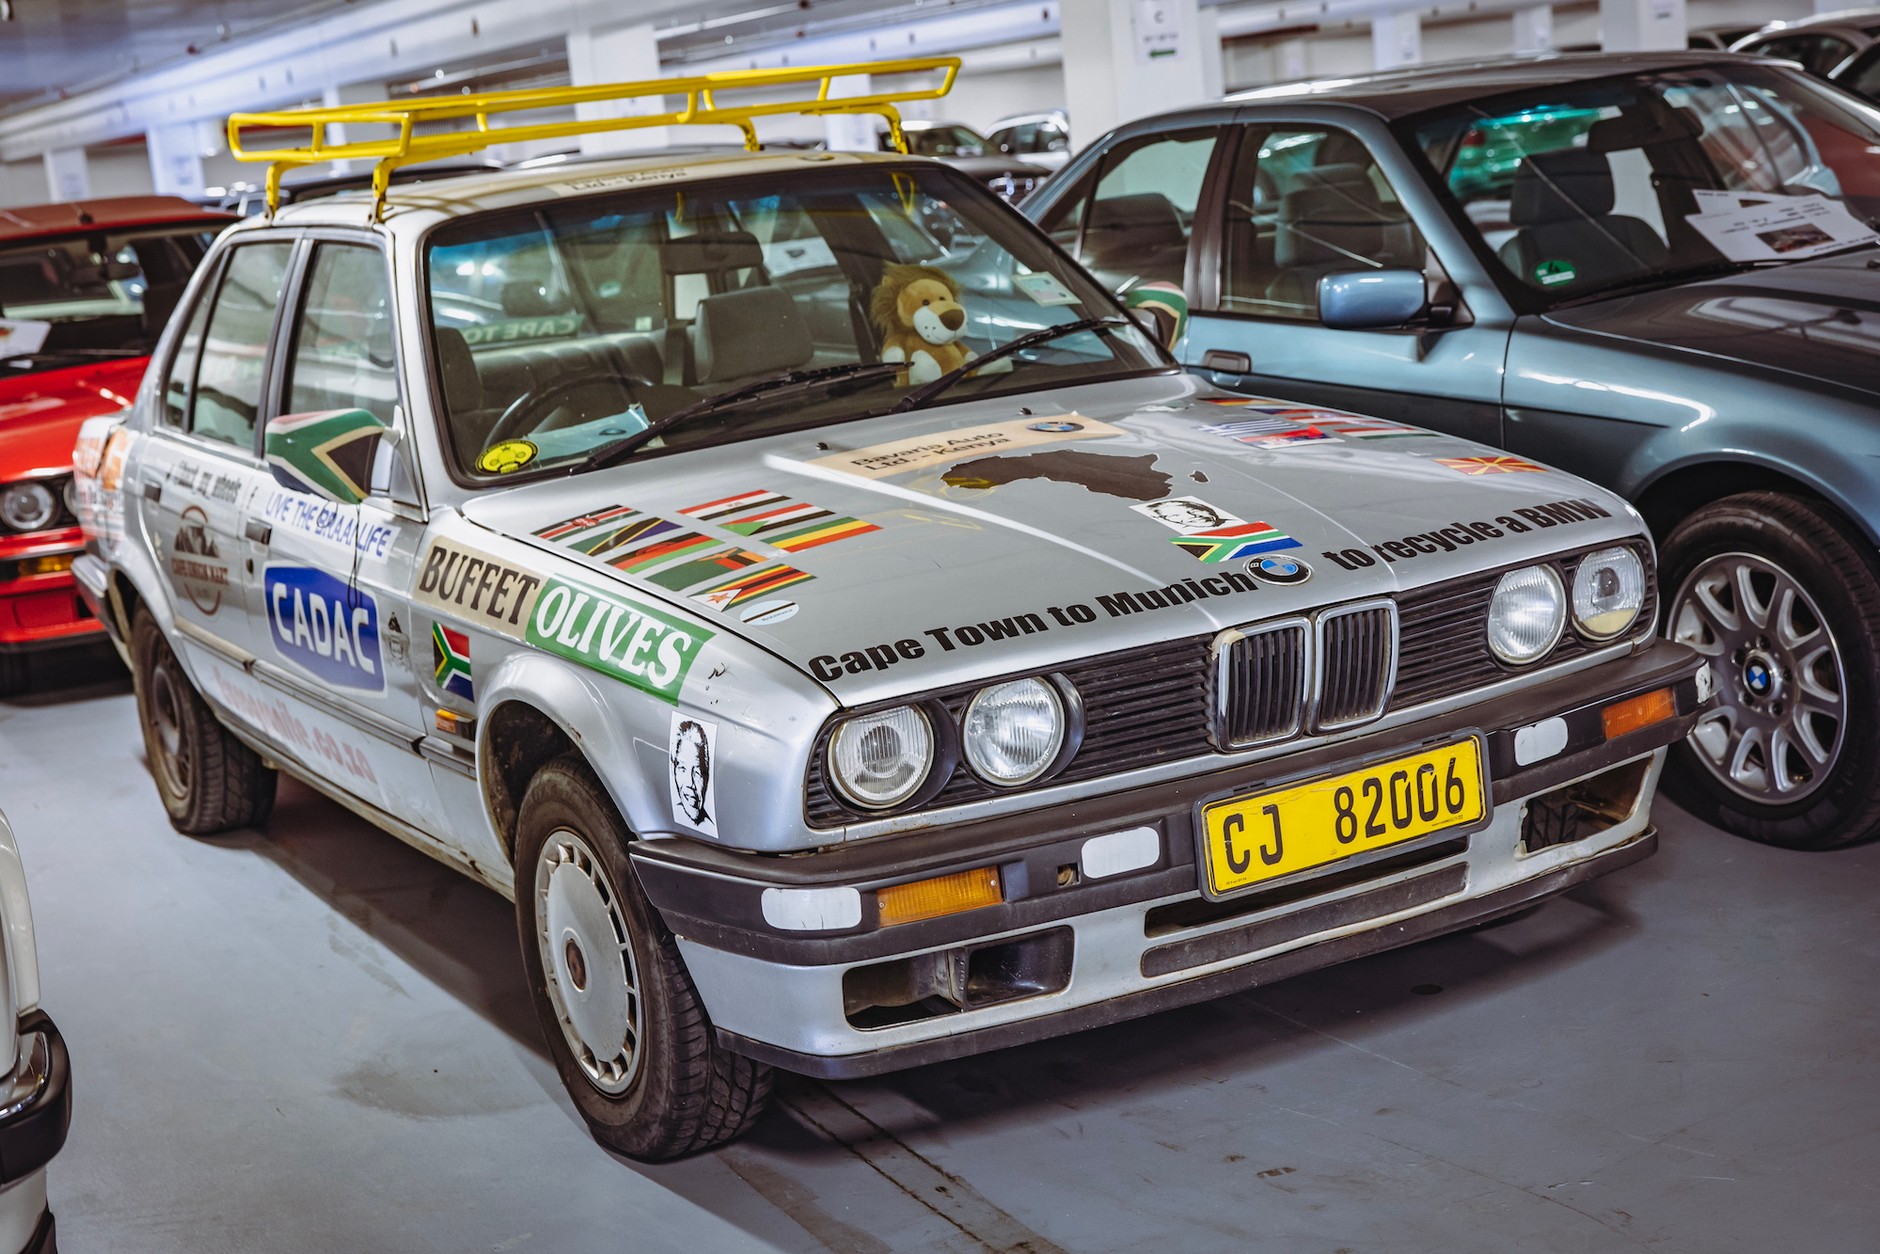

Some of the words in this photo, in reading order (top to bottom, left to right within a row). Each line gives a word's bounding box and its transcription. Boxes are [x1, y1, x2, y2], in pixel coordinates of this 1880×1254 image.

[850, 441, 943, 466] Bavaria
[946, 431, 1004, 446] Auto
[864, 456, 918, 471] Ltd.
[932, 436, 1012, 455] Kenya
[266, 490, 294, 522] LIVE
[291, 500, 319, 532] THE
[356, 522, 392, 557] LIFE
[1494, 515, 1534, 533] a
[1512, 497, 1613, 529] BMW
[1320, 547, 1376, 571] to
[1370, 520, 1505, 563] recycle
[418, 545, 541, 625] BUFFET
[272, 582, 375, 675] CADAC
[535, 585, 692, 690] OLIVES
[808, 638, 926, 682] Cape
[923, 612, 1050, 652] Town
[1046, 603, 1098, 627] to
[1094, 571, 1260, 618] Munich
[1222, 803, 1284, 875] CJ
[1333, 757, 1466, 845] 82006
